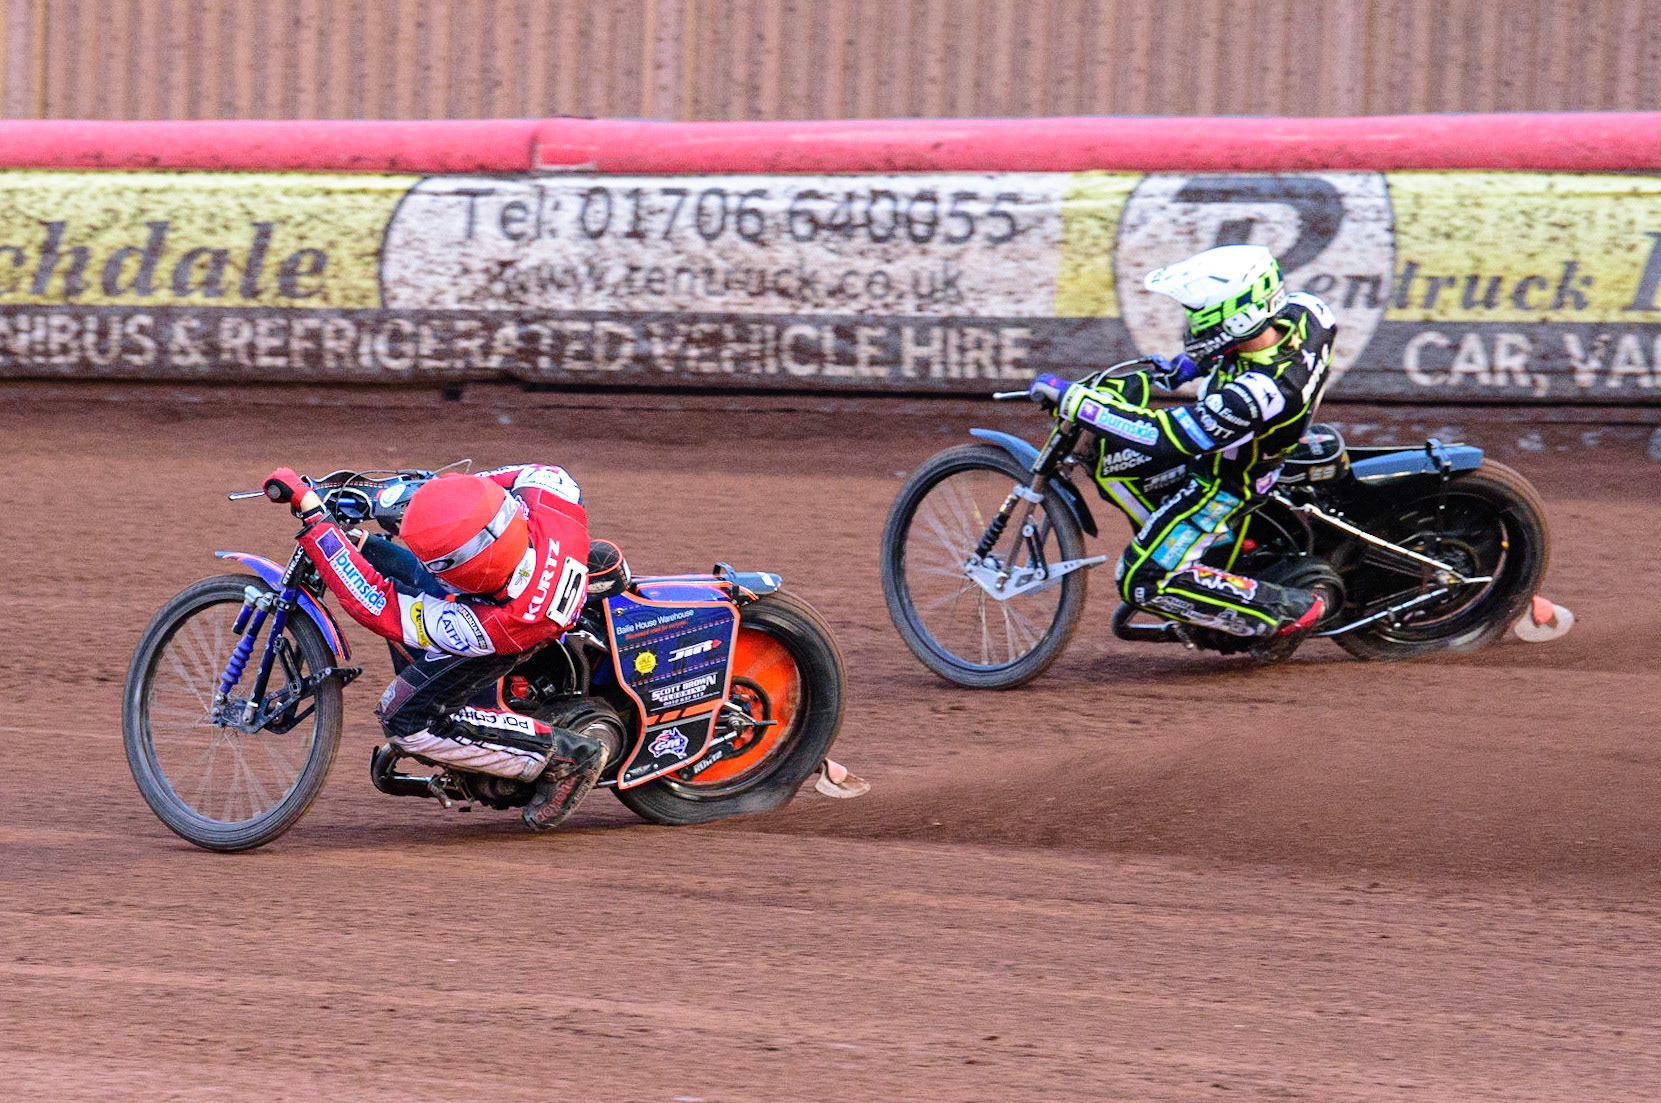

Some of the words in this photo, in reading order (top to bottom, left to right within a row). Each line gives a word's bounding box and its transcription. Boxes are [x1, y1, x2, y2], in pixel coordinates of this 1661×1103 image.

[580, 186, 771, 242] 01706
[902, 325, 1038, 381] HIRE
[1563, 332, 1661, 388] VA
[1099, 408, 1158, 440] burnside
[335, 550, 386, 610] burnside
[522, 537, 560, 621] KURTZ
[635, 619, 657, 630] House
[657, 609, 694, 625] Warehouse
[682, 673, 717, 691] BROWN
